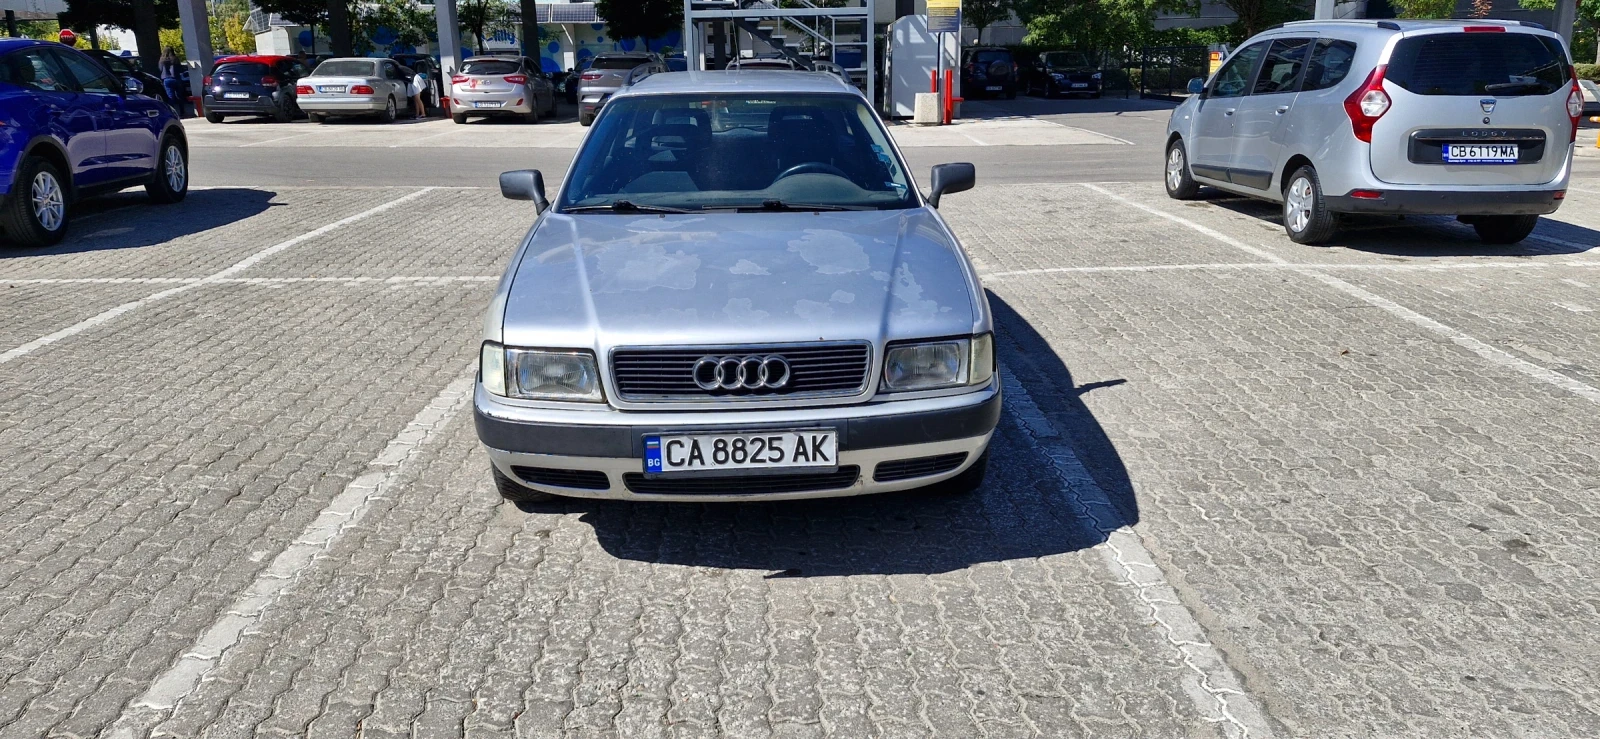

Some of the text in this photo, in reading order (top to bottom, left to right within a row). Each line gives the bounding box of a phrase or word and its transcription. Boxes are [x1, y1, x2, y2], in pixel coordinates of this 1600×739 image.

[647, 434, 830, 467] BG CA 8825 AK
